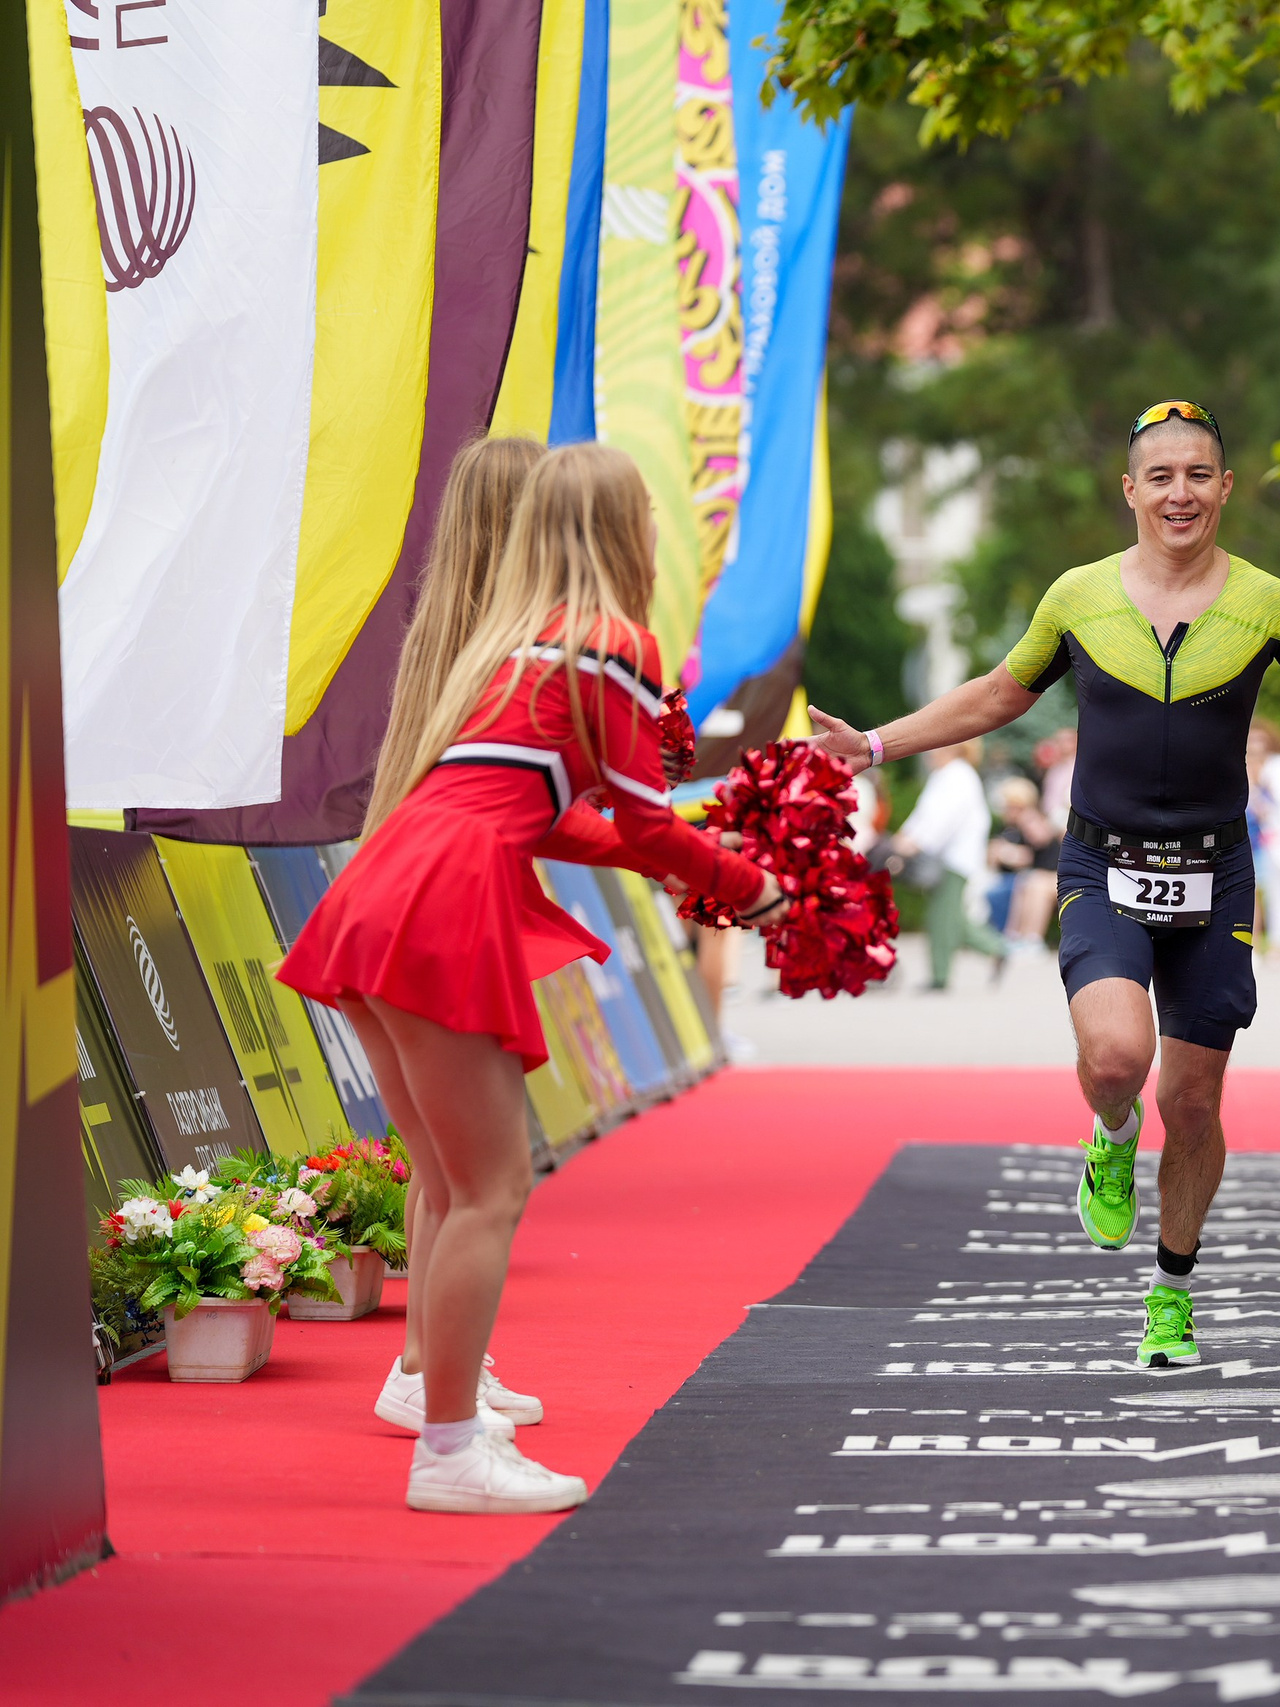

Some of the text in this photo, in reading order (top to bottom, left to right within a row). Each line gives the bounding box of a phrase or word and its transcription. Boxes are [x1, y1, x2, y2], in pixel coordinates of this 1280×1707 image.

[1143, 841, 1181, 850] IRON STAR
[1146, 854, 1161, 863] IRON
[1166, 855, 1182, 864] STAR
[1136, 878, 1186, 907] 223
[1146, 912, 1174, 923] SAMAT
[883, 1359, 1154, 1374] IRON
[842, 1434, 1156, 1451] IRON
[780, 1532, 1149, 1554] IRON
